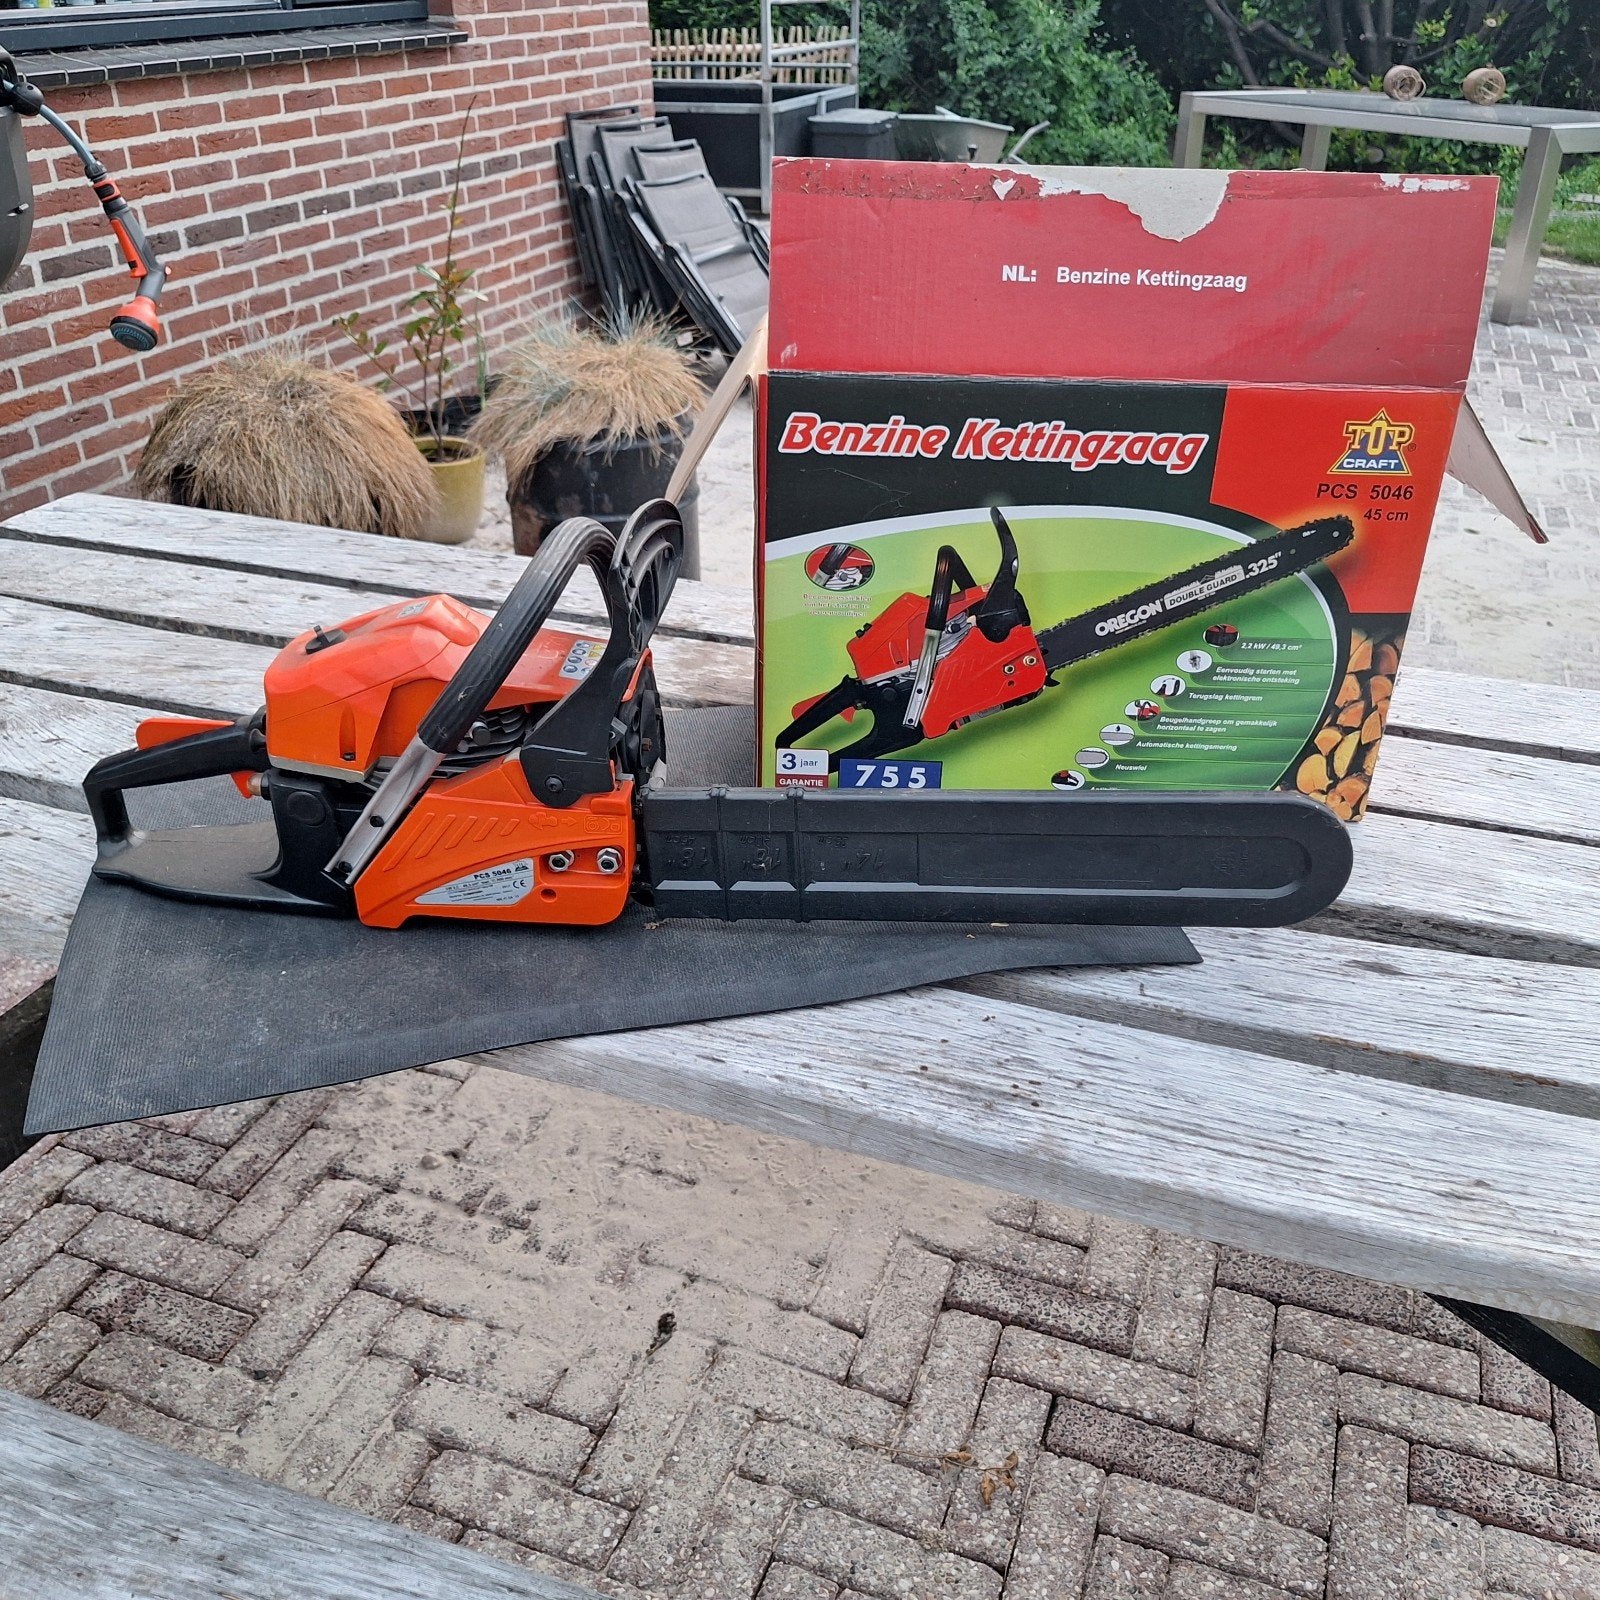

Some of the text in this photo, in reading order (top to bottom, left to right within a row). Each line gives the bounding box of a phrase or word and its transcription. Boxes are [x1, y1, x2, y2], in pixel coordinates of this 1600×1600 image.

[1001, 264, 1248, 292] NL: Benzine Kettingzaag
[778, 411, 1210, 475] Benzine Kettingzaag
[1346, 419, 1412, 456] TOP
[1342, 458, 1400, 469] CRAFT
[1316, 483, 1414, 500] PCS 5046
[1363, 508, 1409, 521] 45 cm
[1169, 586, 1204, 606] DOUBLE
[1206, 573, 1238, 592] GUARD
[1094, 600, 1163, 637] OREGON
[1216, 666, 1255, 676] Eenvoudig
[1255, 668, 1281, 676] starten
[1212, 674, 1300, 685] elektronische ontsteking
[1188, 692, 1263, 702] Terugslag kettingrem
[1159, 716, 1222, 726] Beugelhandgreep
[1235, 719, 1278, 728] gemakkelijk
[1156, 724, 1196, 732] horizontaal
[1204, 726, 1227, 734] zagen
[1136, 740, 1238, 752] Automatische kettingsmering
[781, 752, 819, 770] 3 jaar
[1115, 763, 1148, 771] Neuswiel
[779, 778, 824, 787] GARANTIE
[855, 764, 927, 789] 755
[473, 868, 512, 880] PCS 5046
